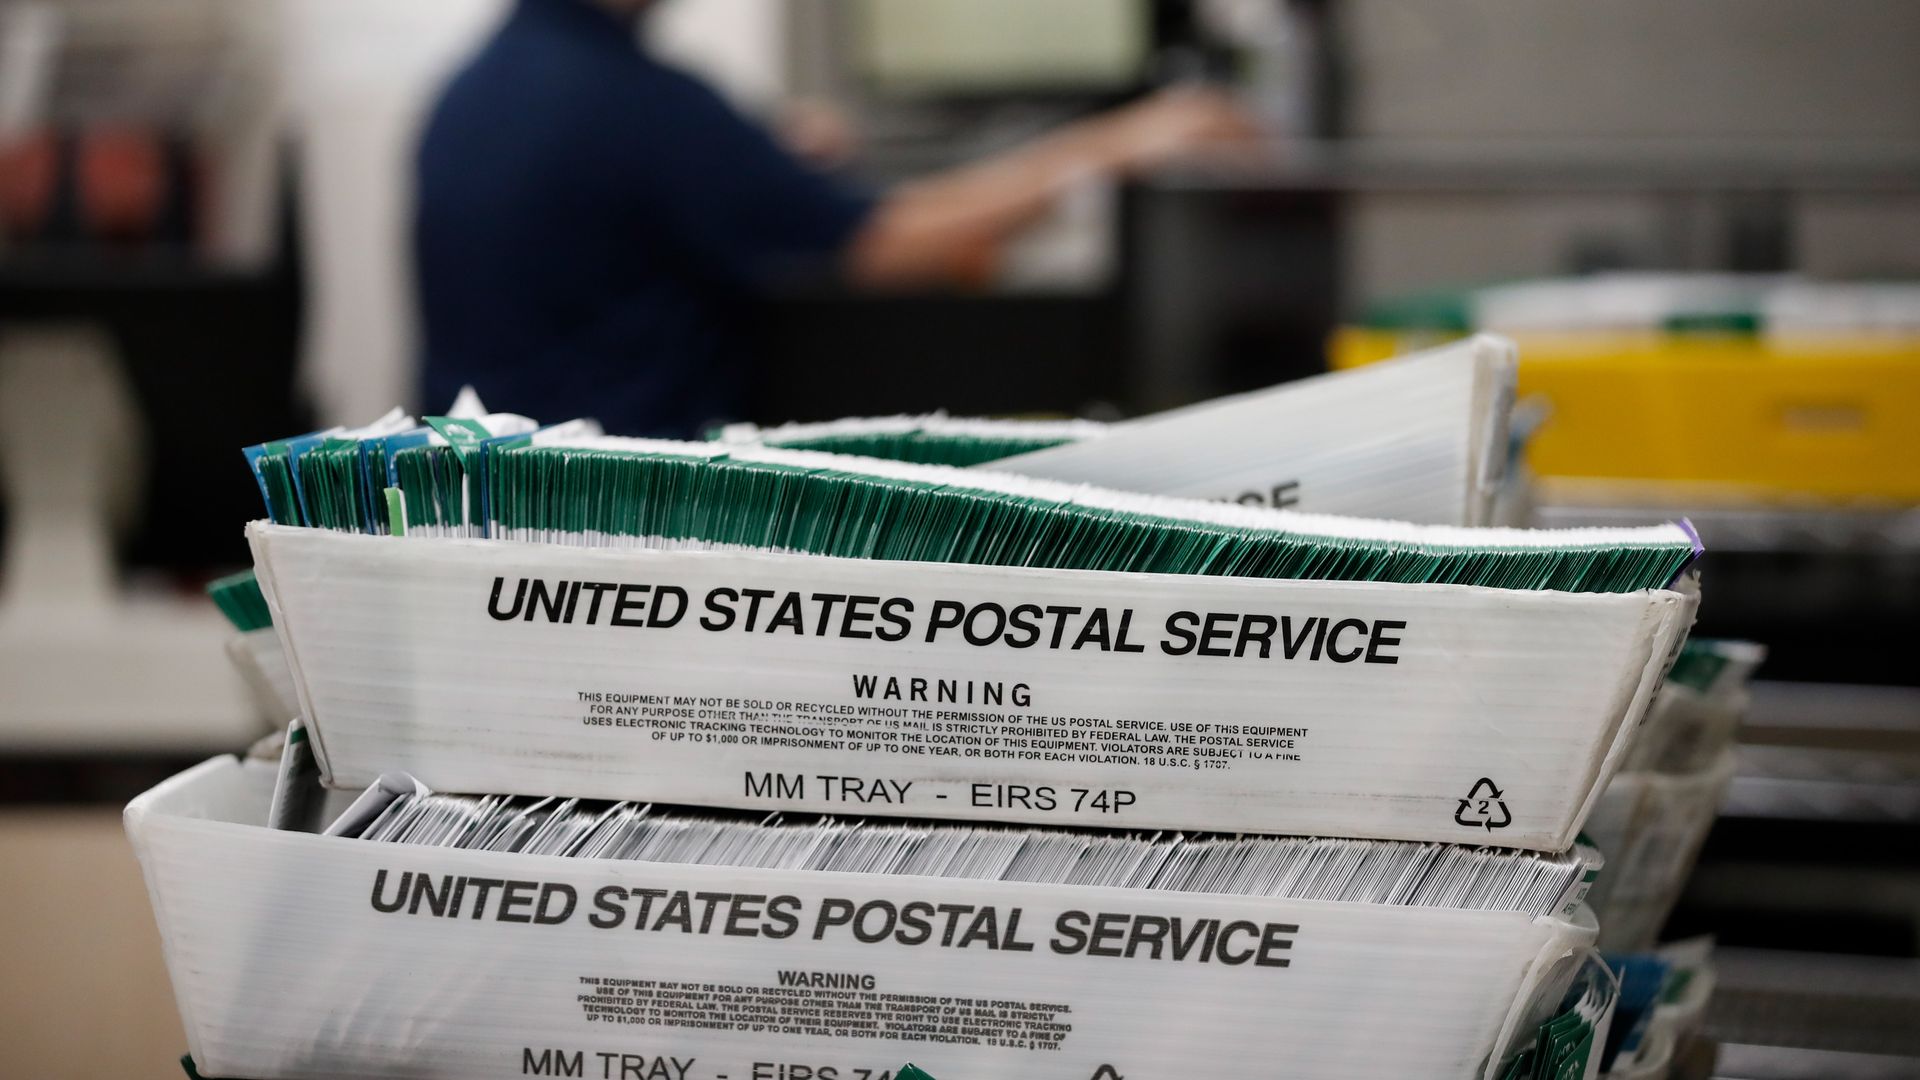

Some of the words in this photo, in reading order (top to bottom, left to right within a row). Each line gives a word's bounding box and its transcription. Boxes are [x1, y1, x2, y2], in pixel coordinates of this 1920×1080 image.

[488, 577, 688, 628] UNITED
[700, 588, 914, 641] STATES
[925, 600, 1144, 652] POSTAL
[1161, 611, 1406, 664] SERVICE
[853, 675, 1030, 707] WARNING
[577, 691, 602, 702] THIS
[605, 692, 670, 705] EQUIPMENT
[673, 696, 696, 705] MAY
[699, 697, 722, 707] NOT
[725, 698, 740, 708] BE
[743, 699, 773, 710] SOLD
[775, 701, 792, 711] OR
[794, 702, 854, 715] RECYCLED
[857, 706, 908, 718] WITHOUT
[911, 709, 933, 719] THE
[936, 710, 1004, 723] PERMISSION
[1007, 714, 1023, 724] OF
[1026, 715, 1048, 725] THE
[1050, 716, 1066, 726] US
[1068, 717, 1113, 728] POSTAL
[1115, 719, 1166, 731] SERVICE.
[1170, 722, 1192, 733] USE
[1195, 723, 1211, 733] OF
[1242, 725, 1308, 738] EQUIPMENT
[590, 704, 612, 714] FOR
[615, 706, 638, 715] ANY
[641, 706, 694, 718] PURPOSE
[698, 709, 736, 720] OTHER
[932, 722, 942, 731] IS
[945, 723, 998, 734] STRICTLY
[1000, 726, 1068, 738] PROHIBITED
[1071, 729, 1087, 739] BY
[1089, 730, 1142, 742] FEDERAL
[1144, 733, 1171, 743] LAW.
[1174, 734, 1196, 744] THE
[1199, 735, 1243, 746] POSTAL
[1246, 737, 1294, 749] SERVICE
[582, 716, 612, 726] USES
[615, 717, 686, 729] ELECTRONIC
[689, 720, 746, 732] TRACKING
[749, 724, 825, 736] TECHNOLOGY
[828, 728, 843, 738] TO
[846, 730, 897, 741] MONITOR
[900, 732, 922, 742] THE
[925, 734, 981, 745] LOCATION
[984, 737, 1000, 746] OF
[1002, 737, 1028, 747] THIS
[1030, 739, 1098, 752] EQUIPMENT.
[1100, 742, 1164, 754] VIOLATORS
[1166, 745, 1190, 755] ARE
[1192, 747, 1242, 759] SUBJECT
[651, 731, 666, 740] OF
[670, 732, 685, 741] UP
[688, 732, 702, 742] TO
[705, 733, 738, 744] $1,000
[741, 735, 757, 744] OR
[760, 736, 845, 750] IMPRISONMENT
[847, 741, 862, 750] OF
[866, 742, 881, 752] UP
[883, 743, 898, 753] TO
[901, 744, 925, 754] ONE
[928, 746, 961, 756] YEAR,
[964, 748, 981, 757] OR
[984, 749, 1014, 759] BOTH
[1018, 750, 1041, 760] FOR
[1044, 751, 1075, 761] EACH
[1078, 753, 1140, 765] VIOLATION.
[1143, 756, 1155, 765] 18
[1158, 757, 1190, 767] U.S.C.
[745, 772, 803, 799] MM
[817, 776, 912, 803] TRAY
[972, 784, 1056, 810] EIRS
[1071, 789, 1136, 813] 74P
[1478, 800, 1489, 814] 2
[371, 870, 577, 925] UNITED
[589, 886, 801, 939] STATES
[813, 899, 1034, 951] POSTAL
[1050, 911, 1299, 967] SERVICE
[579, 976, 600, 985] THIS
[602, 977, 656, 988] EQUIPMENT
[659, 981, 678, 989] MAY
[680, 982, 700, 991] NOT
[702, 984, 715, 992] BE
[717, 985, 743, 994] SOLD
[745, 986, 759, 994] OR
[761, 987, 811, 997] RECYCLED
[813, 989, 856, 1000] WITHOUT
[858, 992, 877, 1001] THE
[879, 993, 937, 1004] PERMISSION
[938, 997, 952, 1005] OF
[954, 998, 973, 1006] THE
[975, 999, 988, 1007] US
[990, 1000, 1027, 1010] POSTAL
[1029, 1002, 1072, 1013] SERVICE.
[778, 971, 875, 990] WARNING
[577, 994, 634, 1005] PROHIBITED
[636, 998, 649, 1006] BY
[650, 999, 694, 1009] FEDERAL
[696, 1002, 718, 1010] LAW.
[721, 1003, 739, 1012] THE
[742, 1004, 778, 1014] POSTAL
[780, 1006, 820, 1016] SERVICE
[823, 1009, 872, 1019] RESERVES
[874, 1012, 893, 1020] THE
[895, 1013, 924, 1022] RIGHT
[926, 1014, 939, 1023] TO
[941, 1015, 960, 1024] USE
[962, 1017, 1022, 1029] ELECTRONIC
[1024, 1021, 1072, 1032] TRACKING
[582, 1004, 646, 1015] TECHNOLOGY
[648, 1008, 661, 1016] TO
[663, 1009, 706, 1019] MONITOR
[708, 1012, 726, 1020] THE
[728, 1013, 776, 1023] LOCATION
[778, 1016, 791, 1024] OF
[793, 1017, 821, 1026] THEIR
[823, 1018, 879, 1030] EQUIPMENT.
[586, 1013, 599, 1021] UP
[601, 1014, 614, 1022] TO
[647, 1017, 661, 1025] OR
[663, 1018, 734, 1030] IMPRISONMENT
[736, 1022, 750, 1031] OF
[751, 1024, 765, 1032] UP
[766, 1024, 780, 1032] TO
[782, 1025, 802, 1034] ONE
[804, 1026, 832, 1036] YEAR,
[834, 1028, 848, 1036] OR
[850, 1029, 877, 1038] BOTH
[878, 1030, 898, 1039] FOR
[900, 1032, 927, 1041] EACH
[928, 1033, 980, 1045] VIOLATION.
[522, 1048, 583, 1078] MM
[596, 1053, 695, 1080] TRAY
